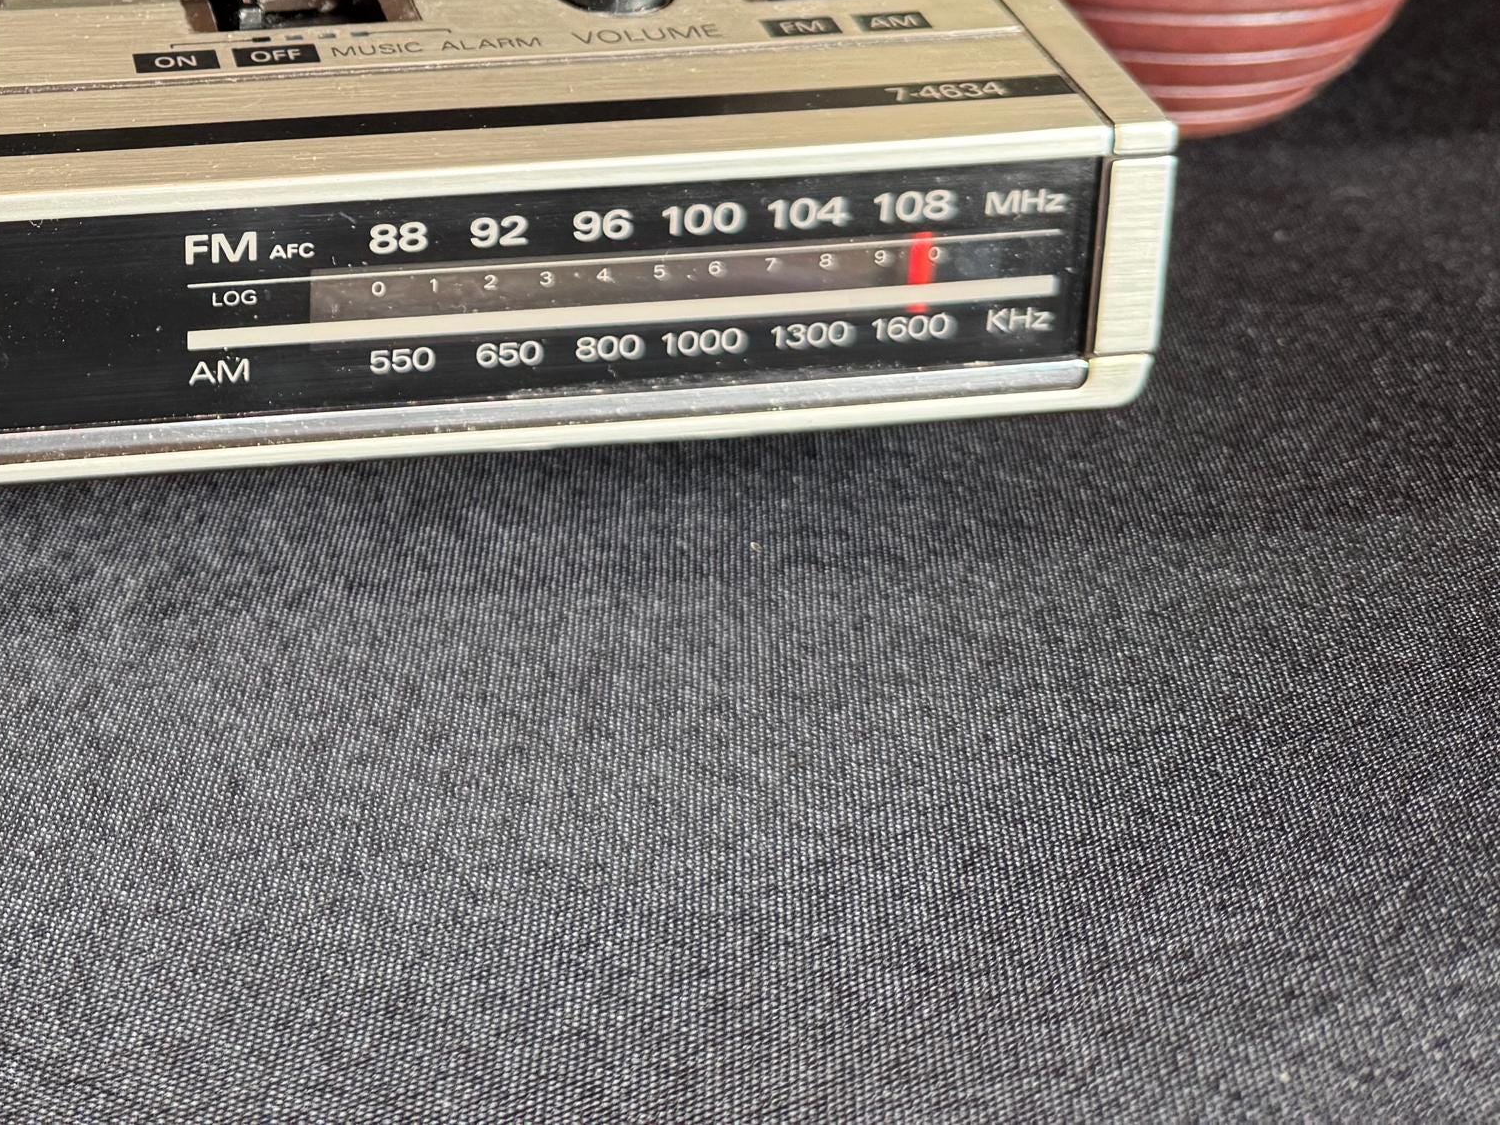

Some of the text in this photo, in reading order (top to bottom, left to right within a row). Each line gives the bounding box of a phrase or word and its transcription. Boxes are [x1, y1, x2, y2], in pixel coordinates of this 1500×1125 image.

[779, 19, 824, 35] FM
[869, 14, 918, 30] AM
[572, 22, 724, 45] VOLUME
[250, 48, 301, 64] OFF
[331, 35, 543, 58] MUSIC ALARM
[154, 53, 198, 70] ON
[885, 81, 1004, 102] 7-4634
[184, 187, 1069, 265] FM AFC 88 92 96 100 104 108 MHz
[211, 289, 258, 307] LOG
[371, 281, 386, 297] 0
[429, 278, 438, 293] 1
[484, 274, 498, 290] 2
[540, 271, 554, 287] 3
[596, 267, 610, 283] 4
[653, 264, 667, 280] 5
[708, 260, 722, 276] 6
[764, 257, 778, 272] 7
[819, 253, 833, 268] 8
[874, 250, 888, 265] 9
[188, 308, 1055, 386] AM 550 650 800 1000 1300 1600 KHz
